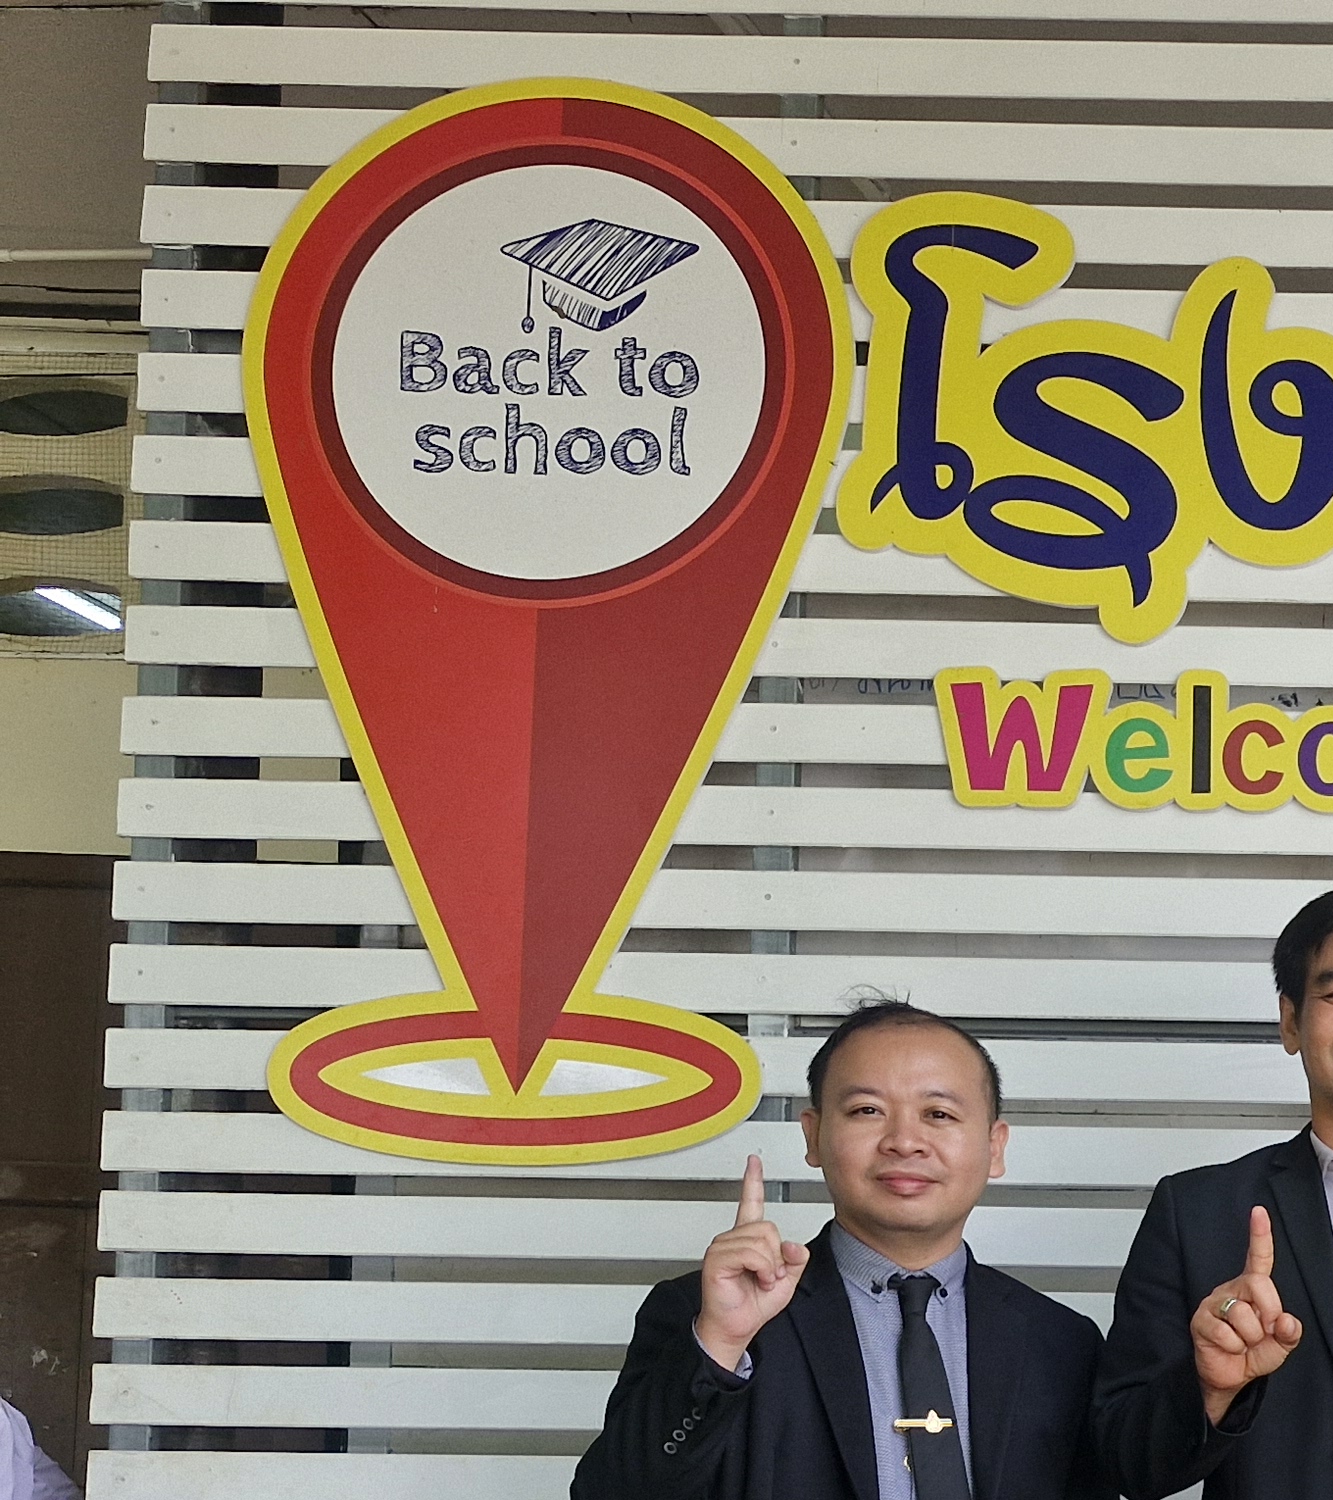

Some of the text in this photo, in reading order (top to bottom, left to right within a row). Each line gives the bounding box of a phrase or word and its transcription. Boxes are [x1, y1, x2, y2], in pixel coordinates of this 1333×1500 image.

[400, 326, 700, 399] Back to
[412, 402, 691, 476] school
